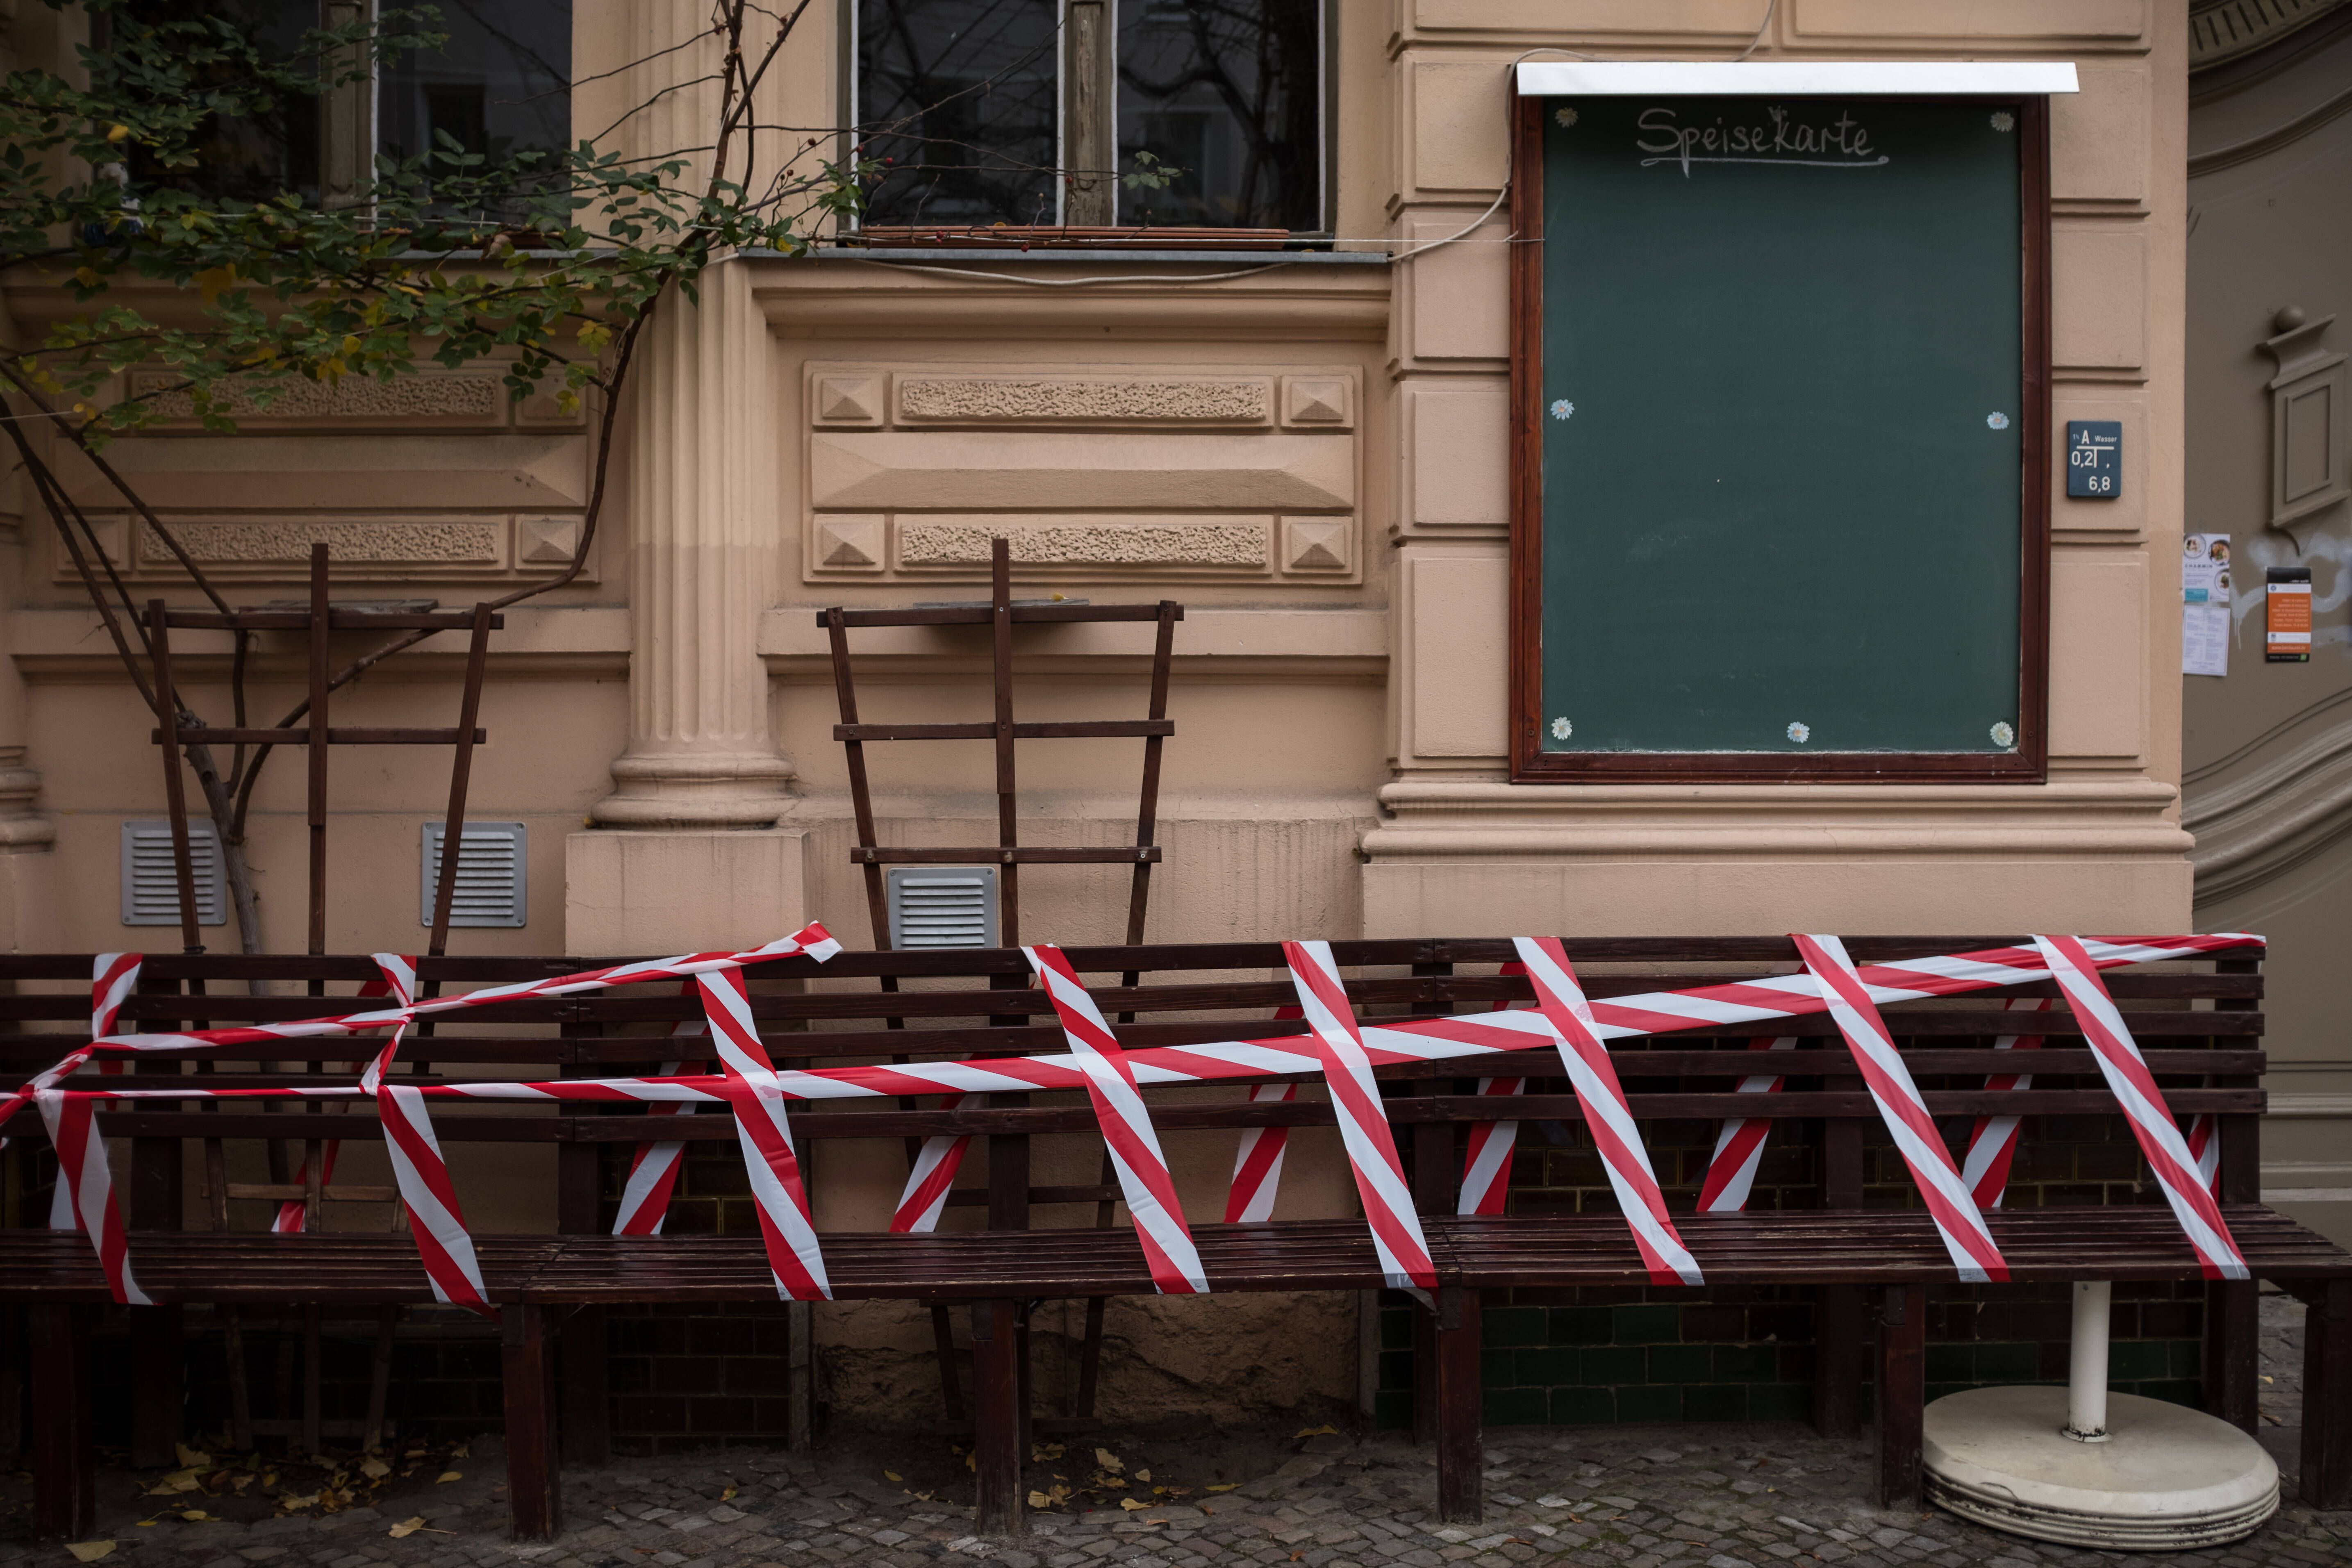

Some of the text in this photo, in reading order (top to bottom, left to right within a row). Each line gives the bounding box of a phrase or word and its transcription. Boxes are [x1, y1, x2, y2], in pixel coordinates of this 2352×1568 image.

[1637, 106, 1874, 178] Speisekarte
[2081, 430, 2090, 444] A
[2072, 451, 2093, 468] 0,2
[2089, 476, 2110, 493] 6,8
